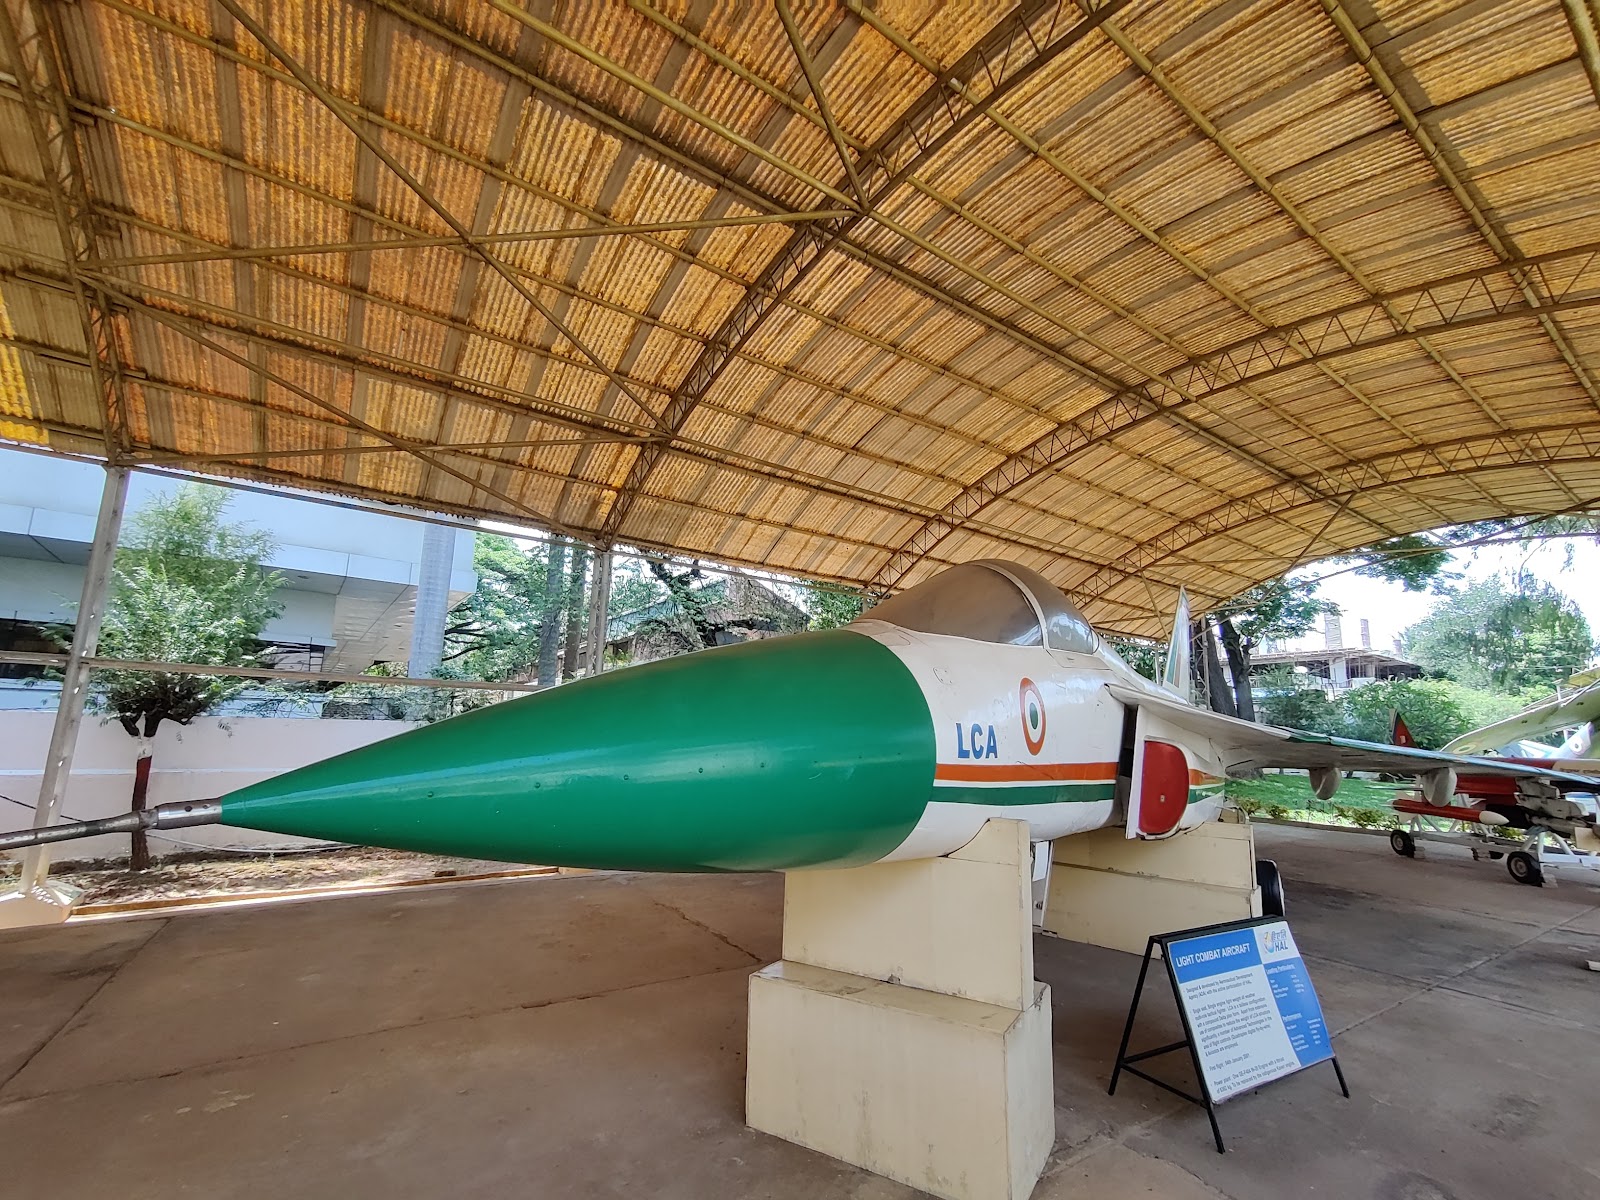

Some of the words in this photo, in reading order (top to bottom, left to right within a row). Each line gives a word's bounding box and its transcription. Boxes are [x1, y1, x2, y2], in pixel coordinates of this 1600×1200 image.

[956, 722, 998, 759] LCA
[1176, 954, 1195, 967] LIGHT
[1195, 948, 1221, 963] COMBAT
[1222, 943, 1250, 957] AIRCRAFT
[1275, 941, 1288, 952] HAL
